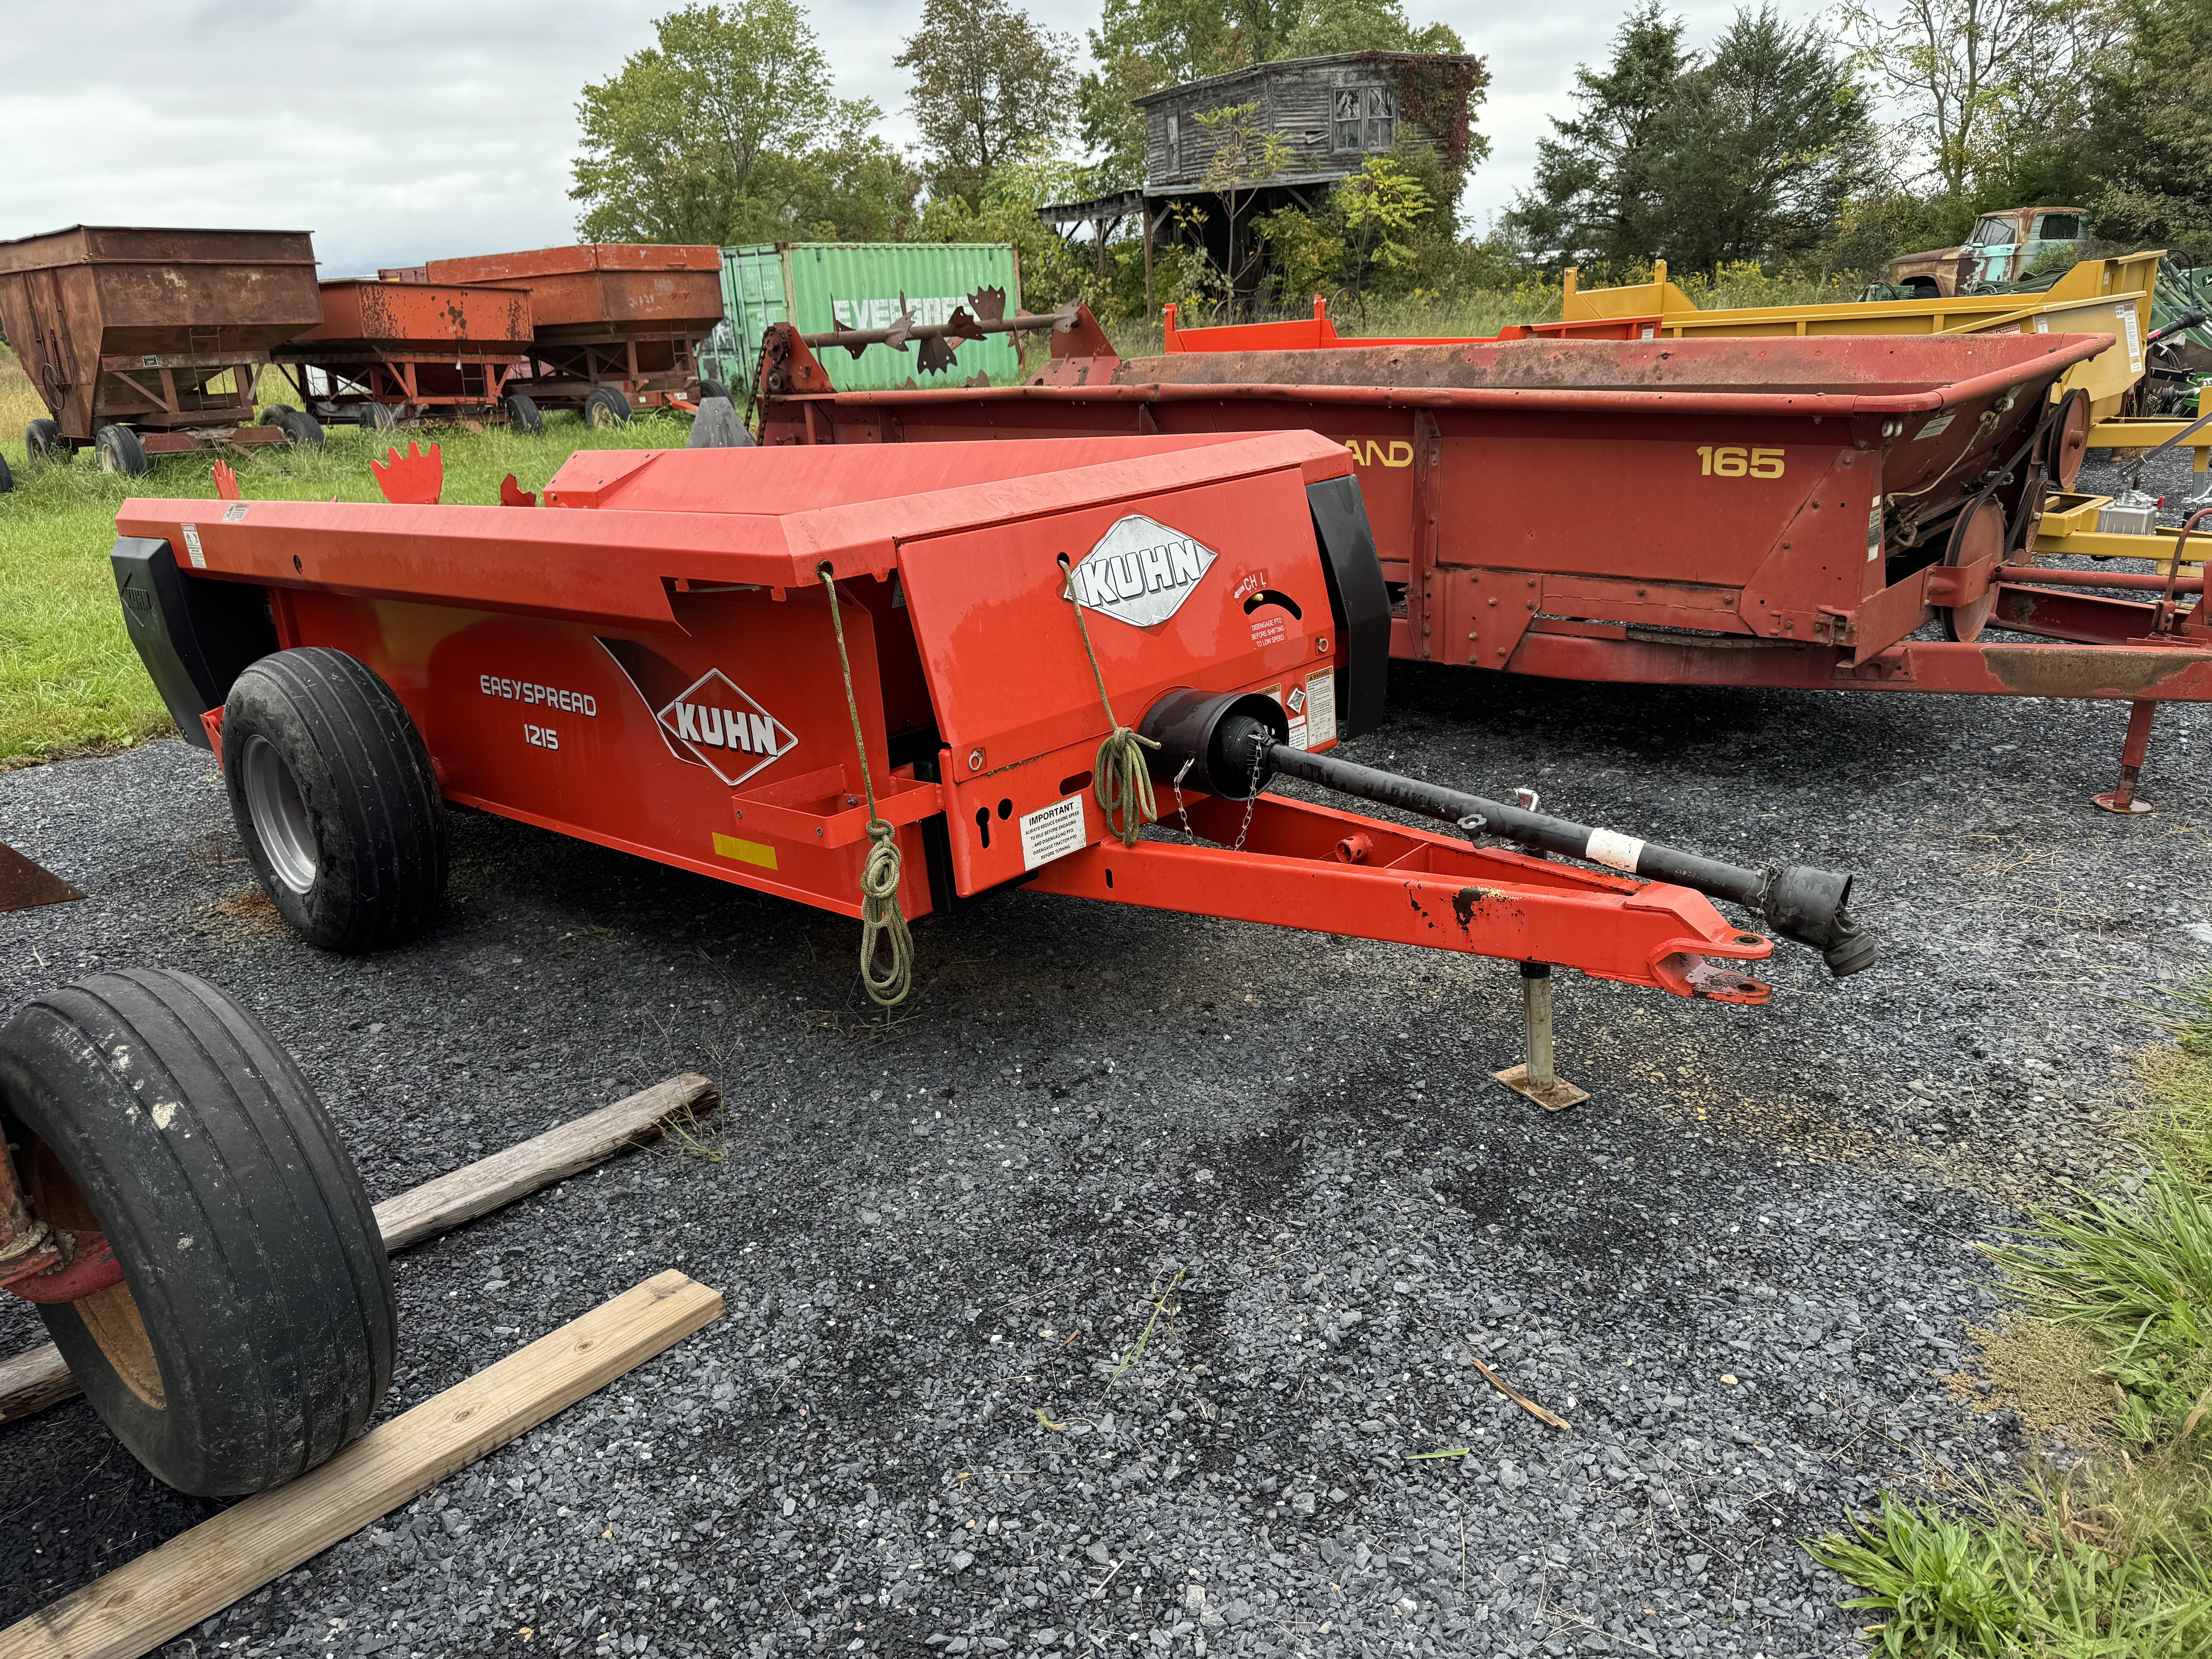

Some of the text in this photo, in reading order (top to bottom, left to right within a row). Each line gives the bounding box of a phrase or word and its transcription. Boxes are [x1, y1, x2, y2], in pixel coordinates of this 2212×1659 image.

[833, 296, 981, 329] EVERGREE
[1345, 440, 1414, 467] AND
[1697, 447, 1785, 479] 165
[1080, 539, 1201, 607] KUHN
[1251, 619, 1274, 631] DISENGAGE
[1251, 625, 1285, 640] BEFORE SHIFTING
[1262, 638, 1271, 646] LOW
[1271, 634, 1285, 643] SPEED
[1313, 670, 1329, 679] WARNING
[480, 674, 597, 717] EASYSPREAD
[524, 724, 559, 751] 1215
[674, 701, 778, 757] KUHN
[1029, 802, 1074, 826] IMPORTANT
[1025, 826, 1040, 835] ALWAYS
[1041, 820, 1055, 829] REDUCE
[1055, 815, 1068, 823] ENGINE
[1044, 827, 1058, 835] BEFORE
[1058, 819, 1076, 830] ENGAGING
[1033, 844, 1053, 855] DISENGAGE
[1054, 837, 1070, 847] TRACTOR
[1042, 831, 1066, 844] DISENGAGING
[1041, 851, 1055, 860] BEFORE
